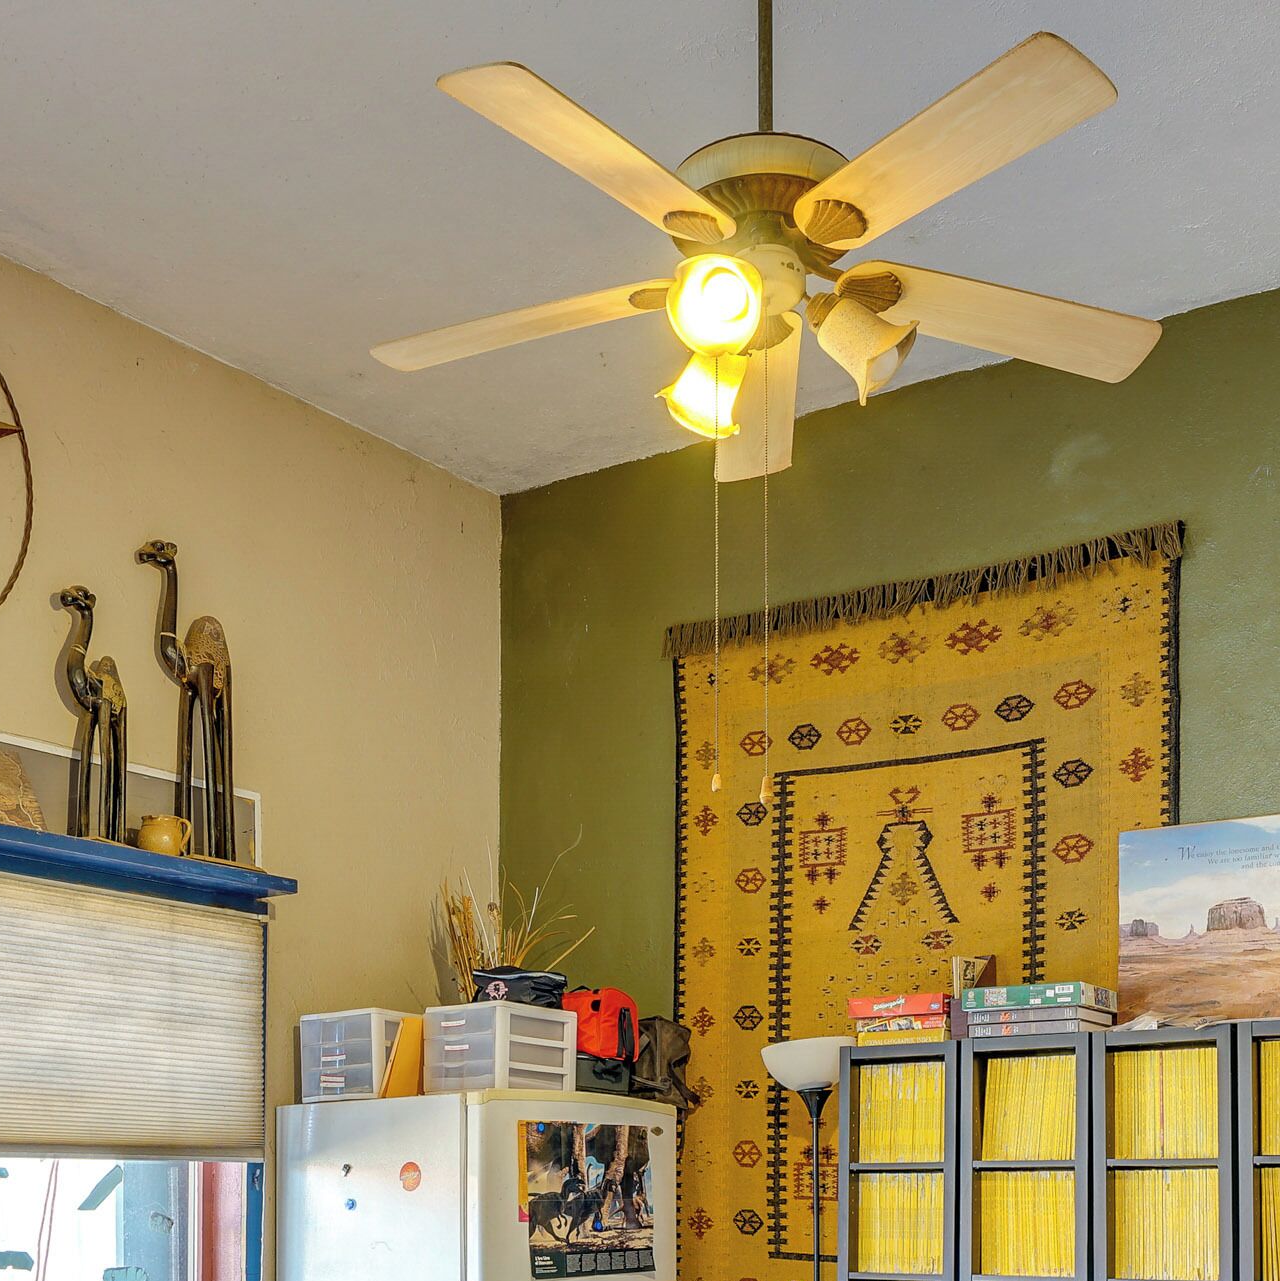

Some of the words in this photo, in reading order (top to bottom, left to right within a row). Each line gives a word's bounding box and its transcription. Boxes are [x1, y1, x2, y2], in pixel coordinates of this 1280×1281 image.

[1216, 848, 1226, 856] the
[1228, 847, 1259, 856] lonesome
[1262, 844, 1274, 852] and
[1244, 853, 1272, 861] familiar
[1256, 861, 1267, 869] the
